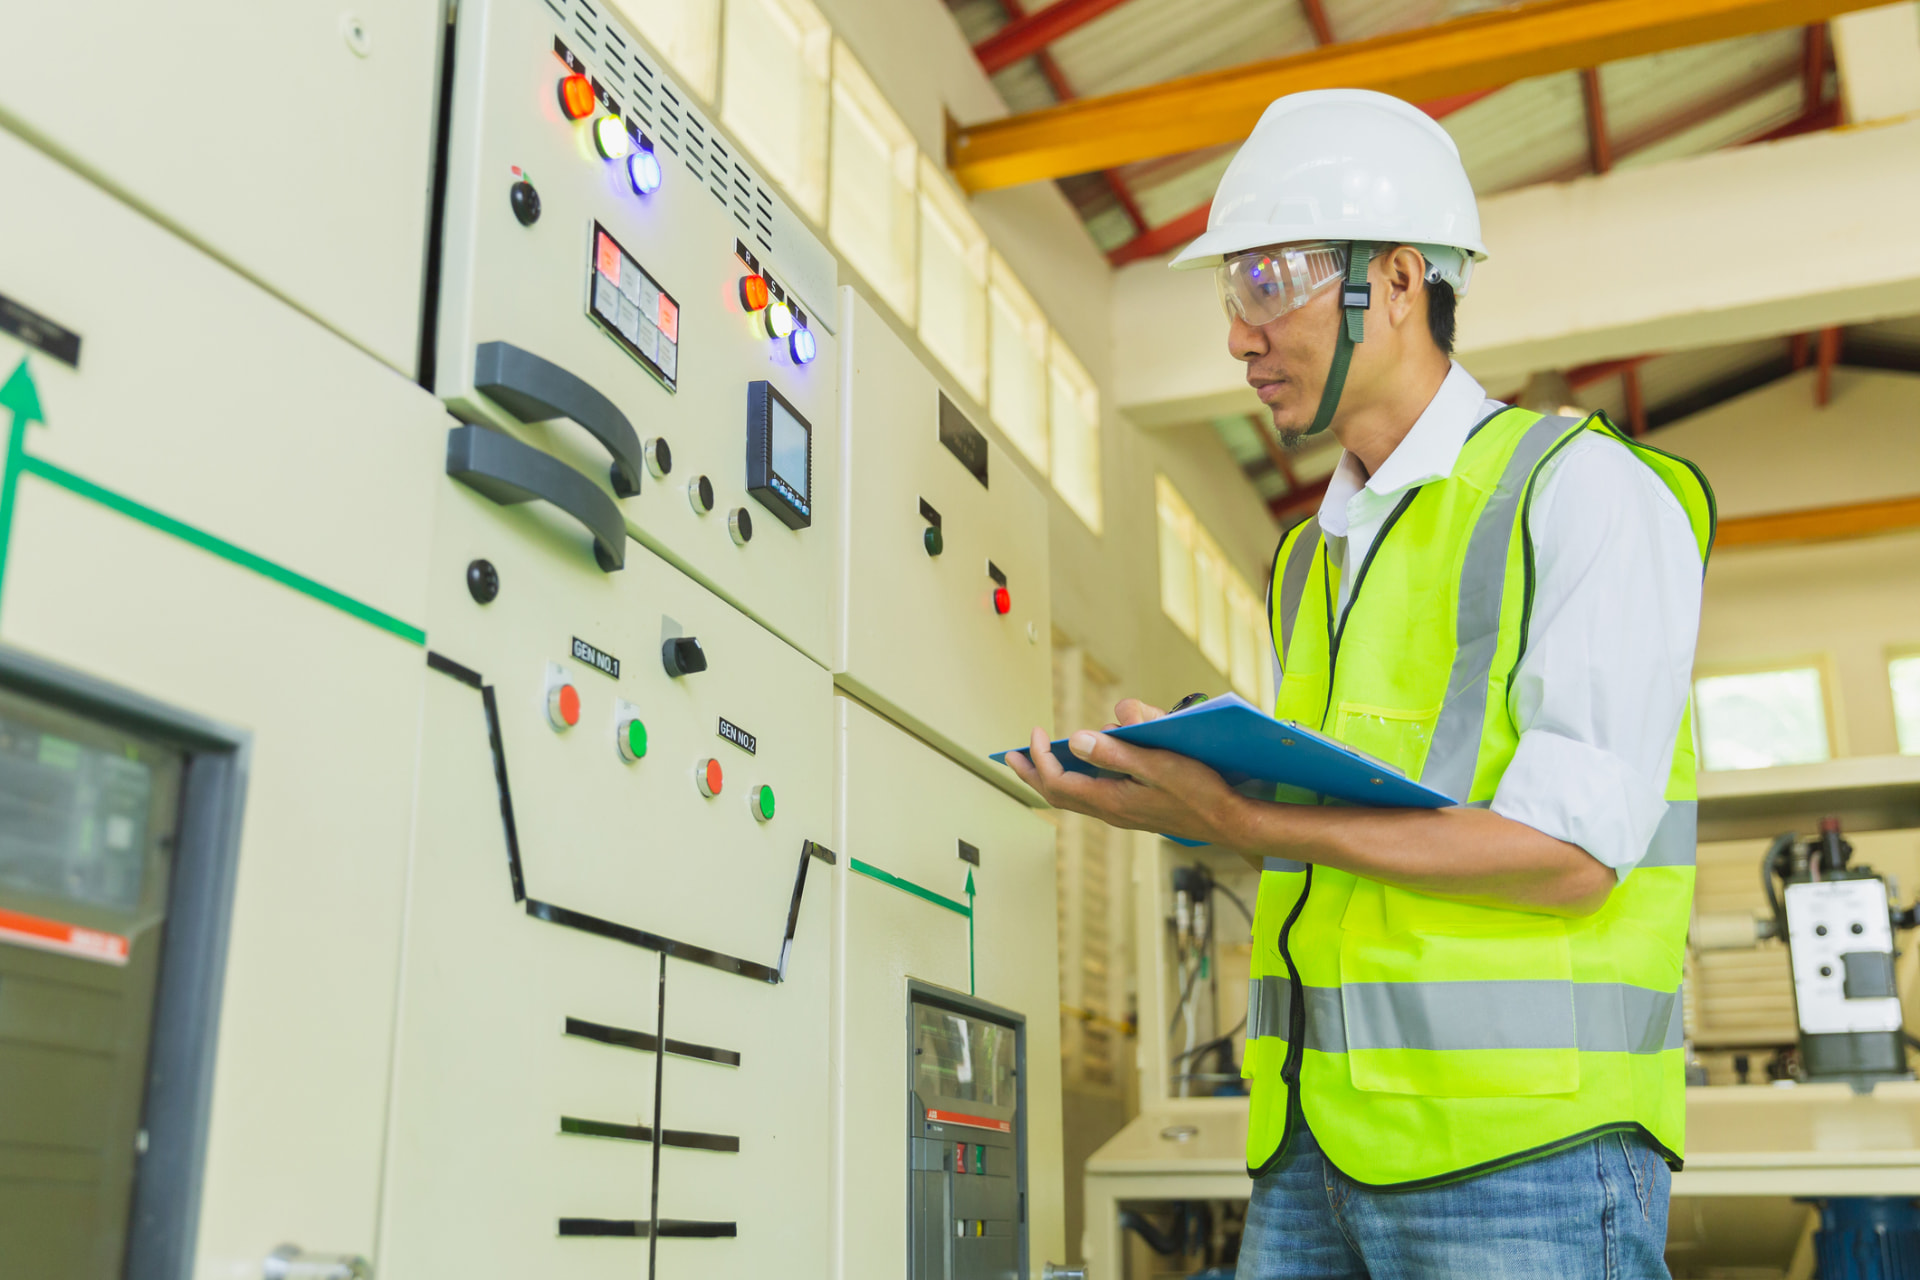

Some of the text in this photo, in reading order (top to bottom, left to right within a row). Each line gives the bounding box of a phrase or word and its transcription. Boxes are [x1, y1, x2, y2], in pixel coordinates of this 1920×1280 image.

[566, 50, 575, 68] R
[602, 92, 610, 107] S
[636, 129, 643, 144] T
[745, 250, 751, 264] R
[771, 280, 776, 293] S
[794, 306, 799, 319] T
[574, 640, 618, 676] GEN NO.1
[720, 720, 755, 752] GEN NO.2
